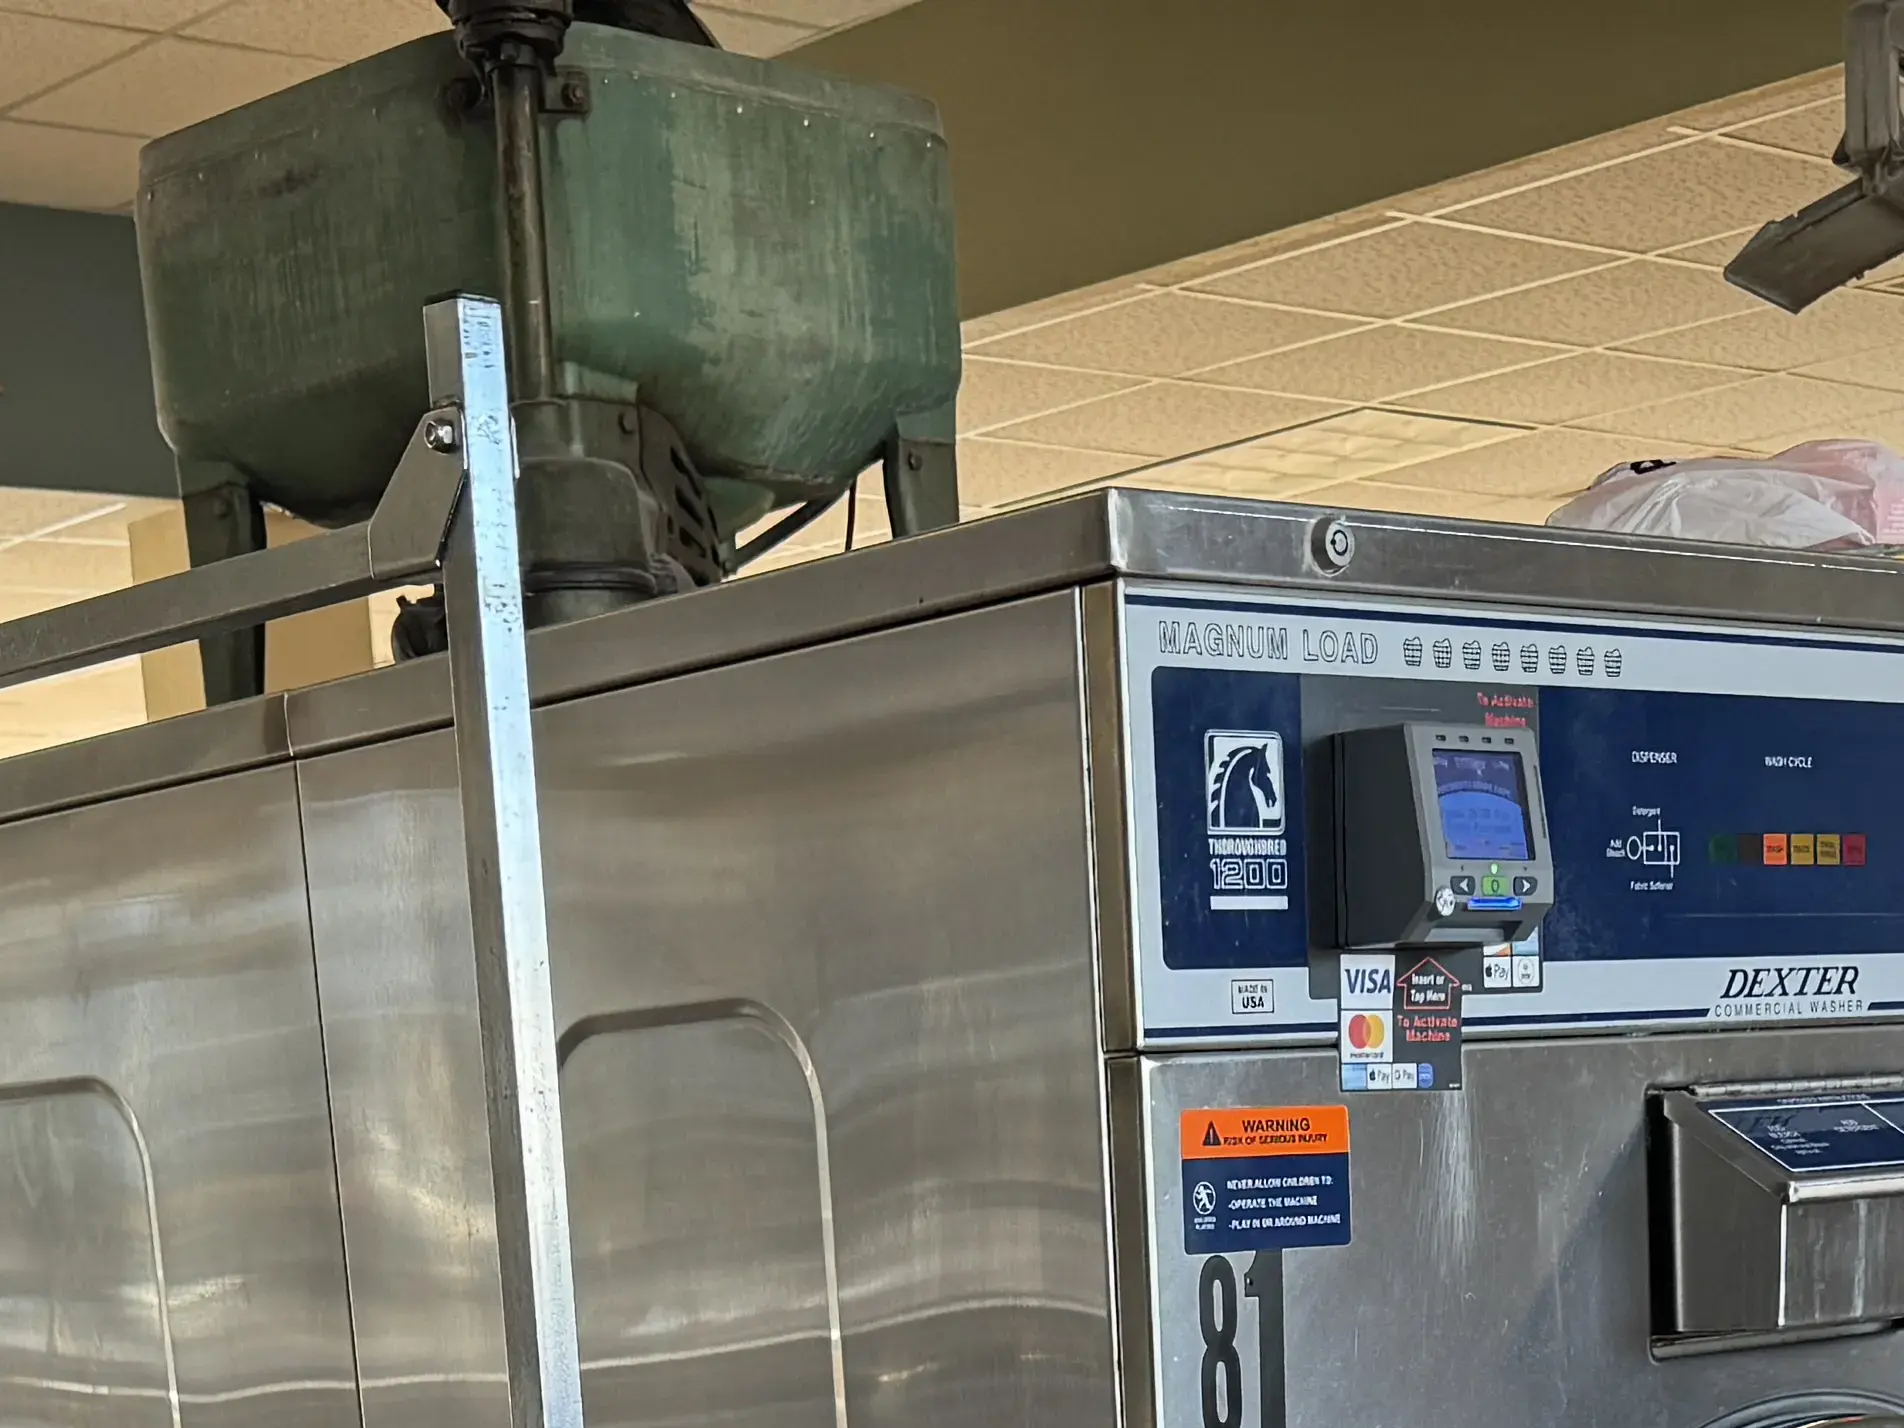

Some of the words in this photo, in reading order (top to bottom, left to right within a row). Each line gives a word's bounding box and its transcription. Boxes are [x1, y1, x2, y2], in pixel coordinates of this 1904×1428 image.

[1158, 620, 1288, 661] MAGNUM
[1302, 629, 1379, 666] LOAD
[1477, 692, 1488, 706] To
[1491, 693, 1534, 708] Activate
[1485, 712, 1527, 728] Machine
[1632, 751, 1678, 764] DISPENSER
[1788, 756, 1813, 768] CYCLE
[1209, 858, 1288, 890] 1200
[1494, 965, 1510, 981] Pay
[1345, 969, 1391, 994] VISA
[1720, 965, 1859, 999] DEXTER
[1242, 995, 1265, 1009] USA
[1411, 990, 1424, 1004] Tap
[1715, 1001, 1802, 1017] COMMERCIAL
[1810, 1000, 1863, 1013] WASHER
[1397, 1015, 1410, 1027] To
[1414, 1016, 1457, 1028] Activate
[1406, 1030, 1450, 1042] Machine
[1242, 1118, 1310, 1133] WARNING
[1224, 1136, 1244, 1146] RISK
[1245, 1135, 1255, 1145] OF
[1259, 1134, 1296, 1144] SERIOUS
[1298, 1134, 1327, 1143] INJURY
[1268, 1197, 1282, 1208] THE
